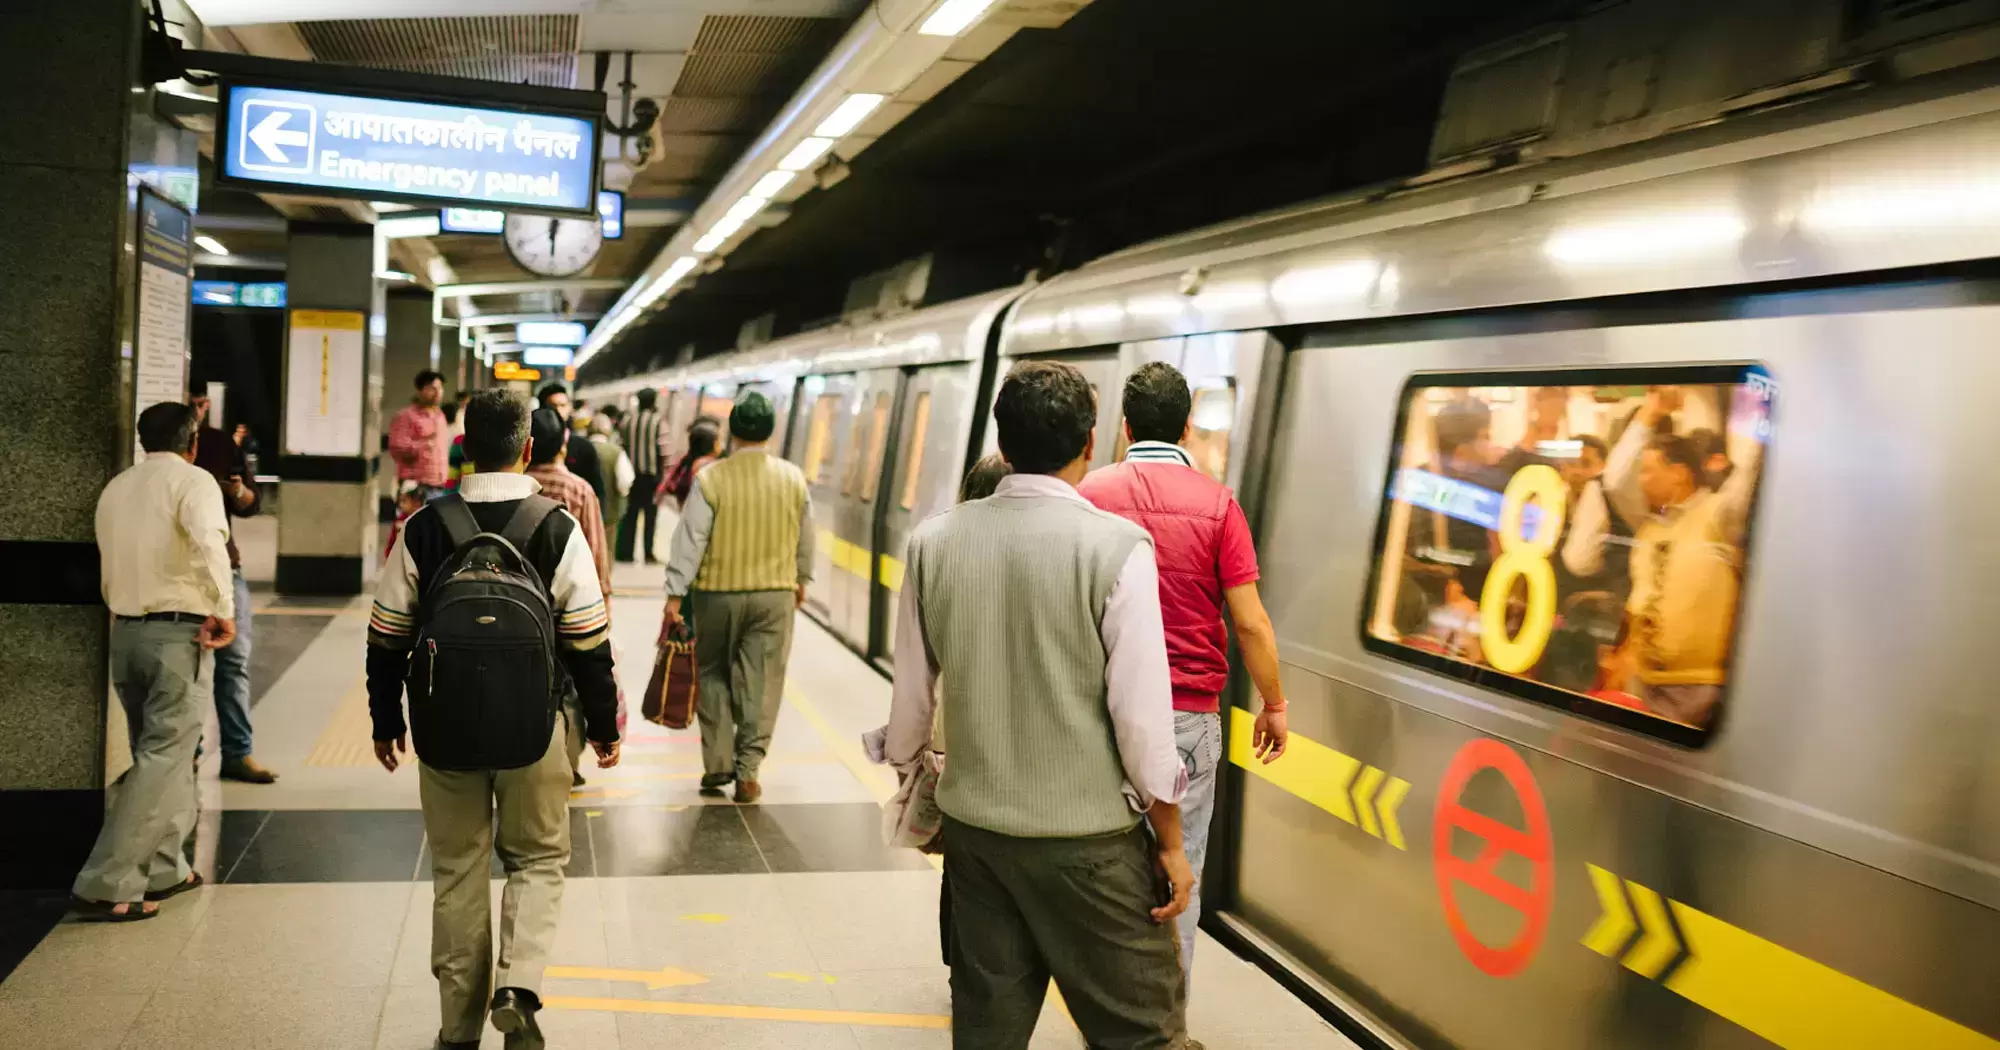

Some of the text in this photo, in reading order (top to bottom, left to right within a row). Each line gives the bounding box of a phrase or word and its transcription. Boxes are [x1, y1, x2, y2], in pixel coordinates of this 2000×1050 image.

[323, 109, 581, 160] आपातकालीन पैनल
[319, 150, 559, 197] Emergency panel
[1480, 464, 1566, 674] 8
